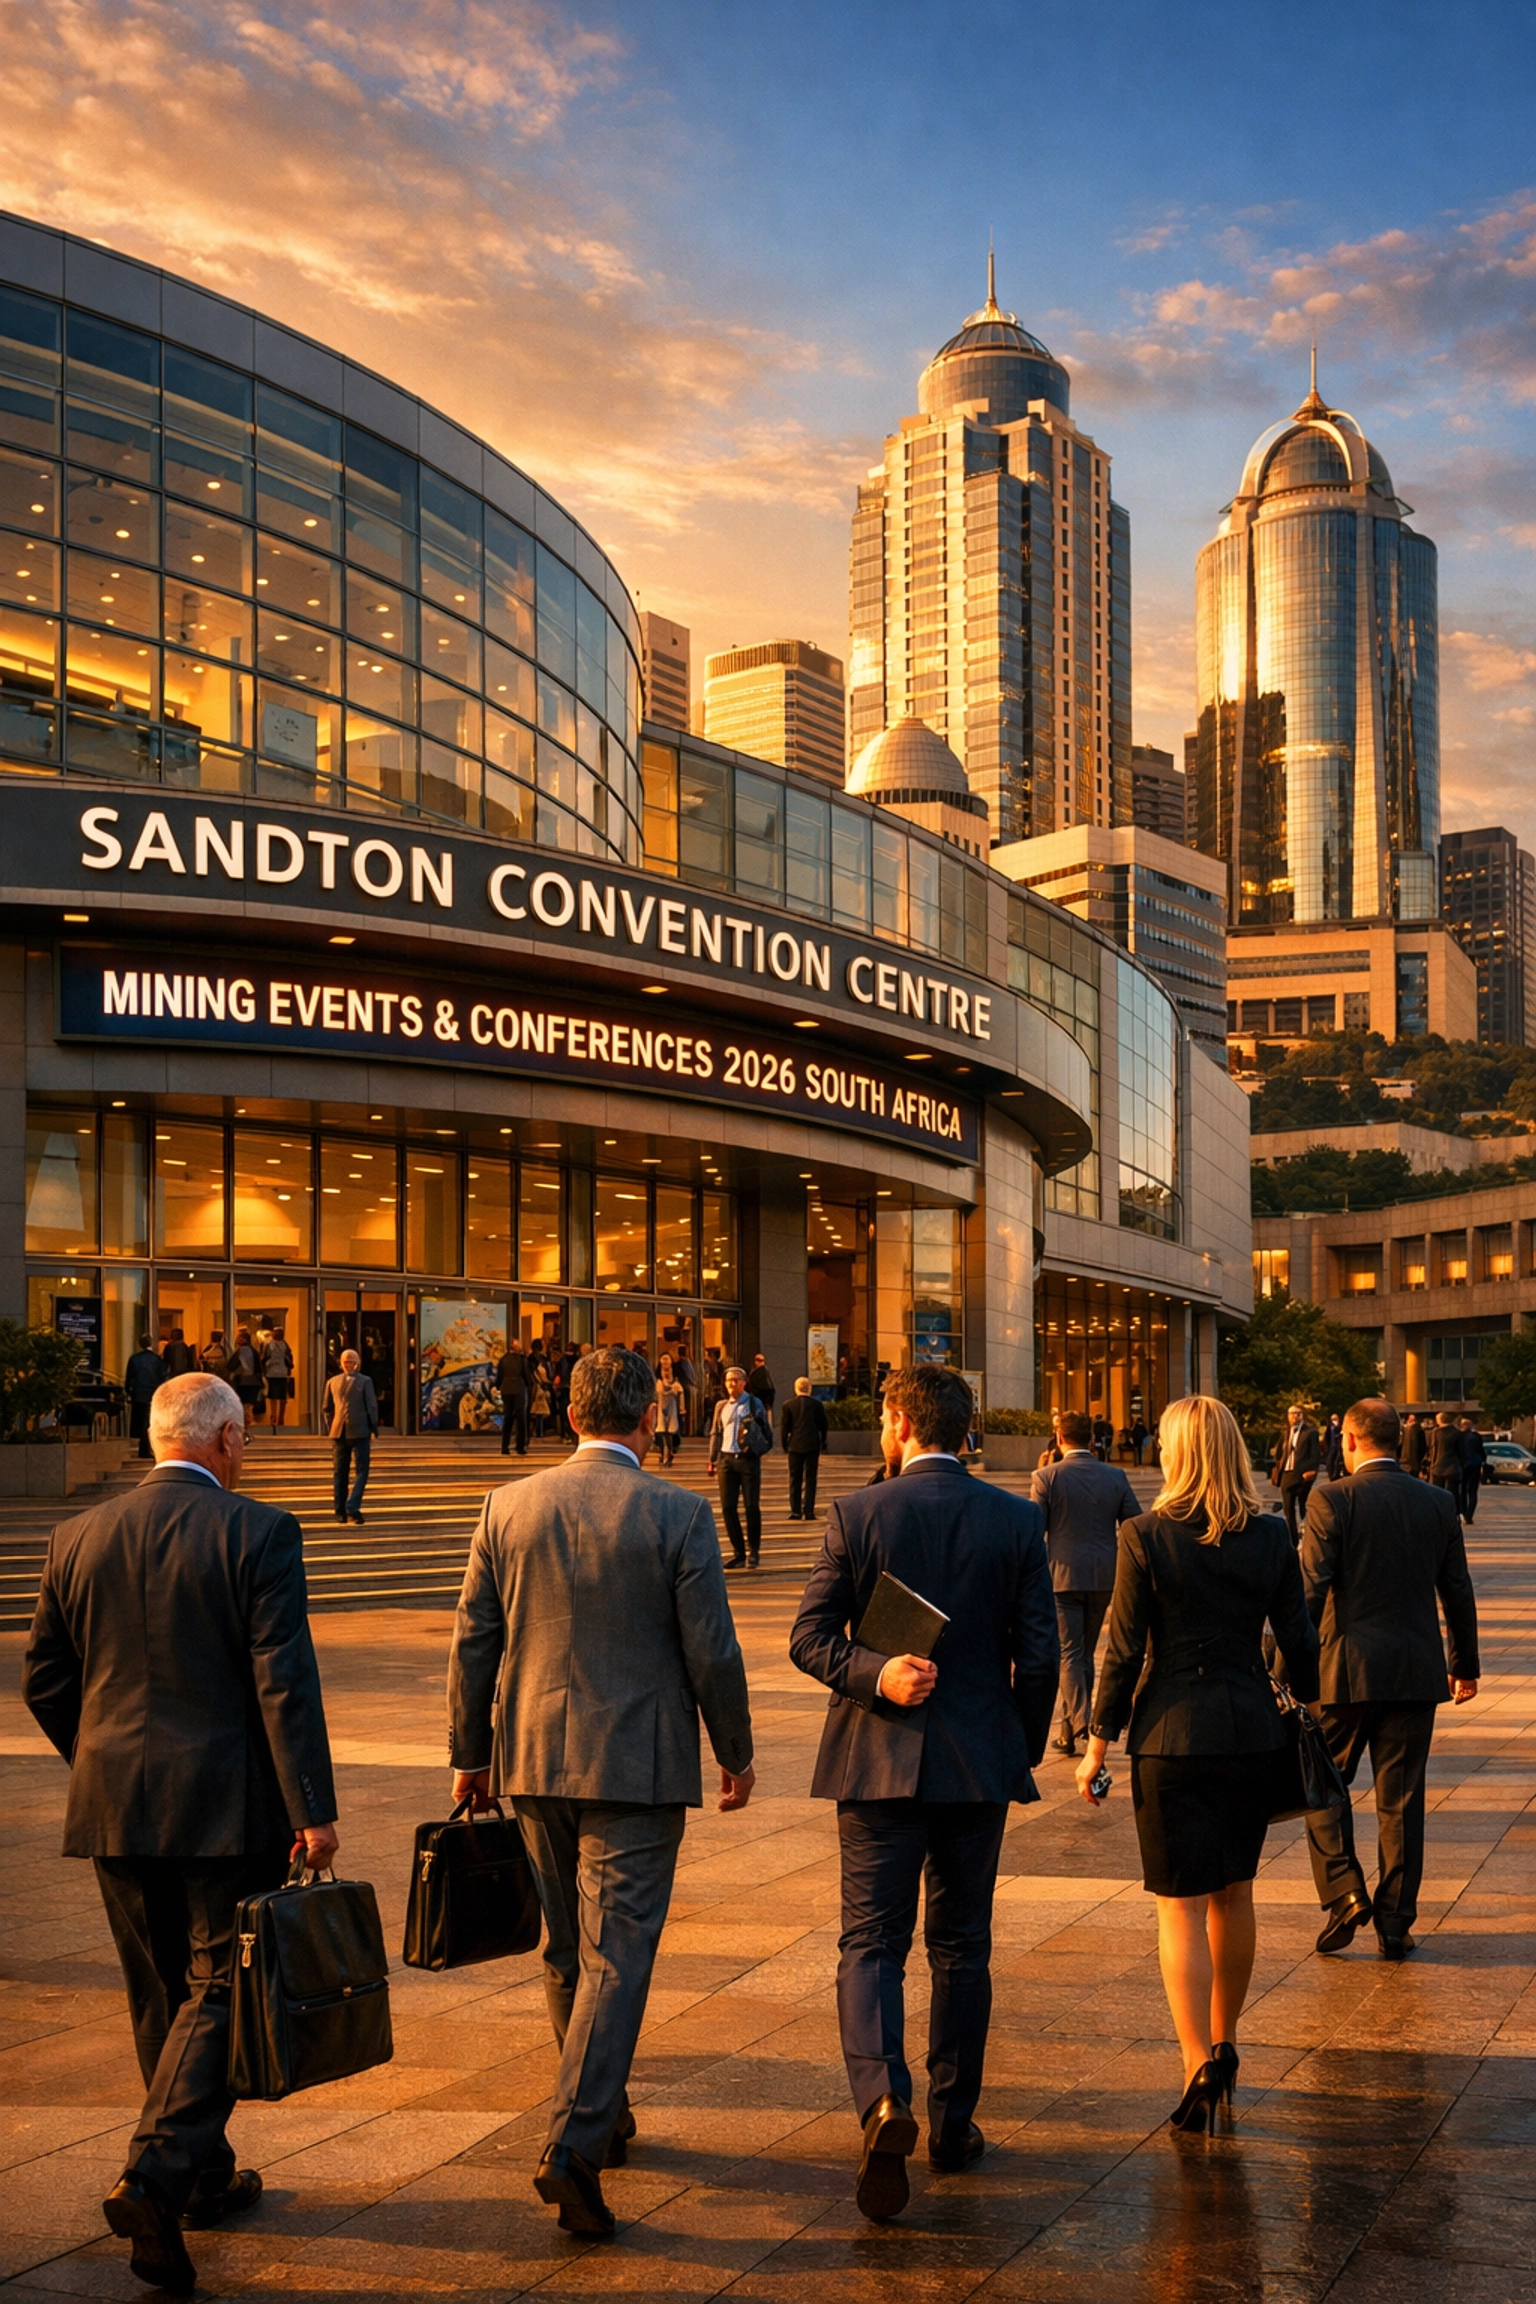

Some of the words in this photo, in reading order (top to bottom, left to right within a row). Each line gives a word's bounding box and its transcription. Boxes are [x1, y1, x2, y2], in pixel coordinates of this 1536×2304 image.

[79, 806, 454, 908] SANDTON
[487, 863, 832, 992] CONVENTION
[847, 955, 992, 1041] CENTRE
[102, 970, 256, 1023] MINING
[268, 982, 423, 1039] EVENTS
[433, 998, 459, 1041] &
[469, 1003, 714, 1079] CONFERENCES
[722, 1045, 796, 1095] 2026
[804, 1063, 887, 1116] SOUTH
[891, 1085, 963, 1142] AFRICA
